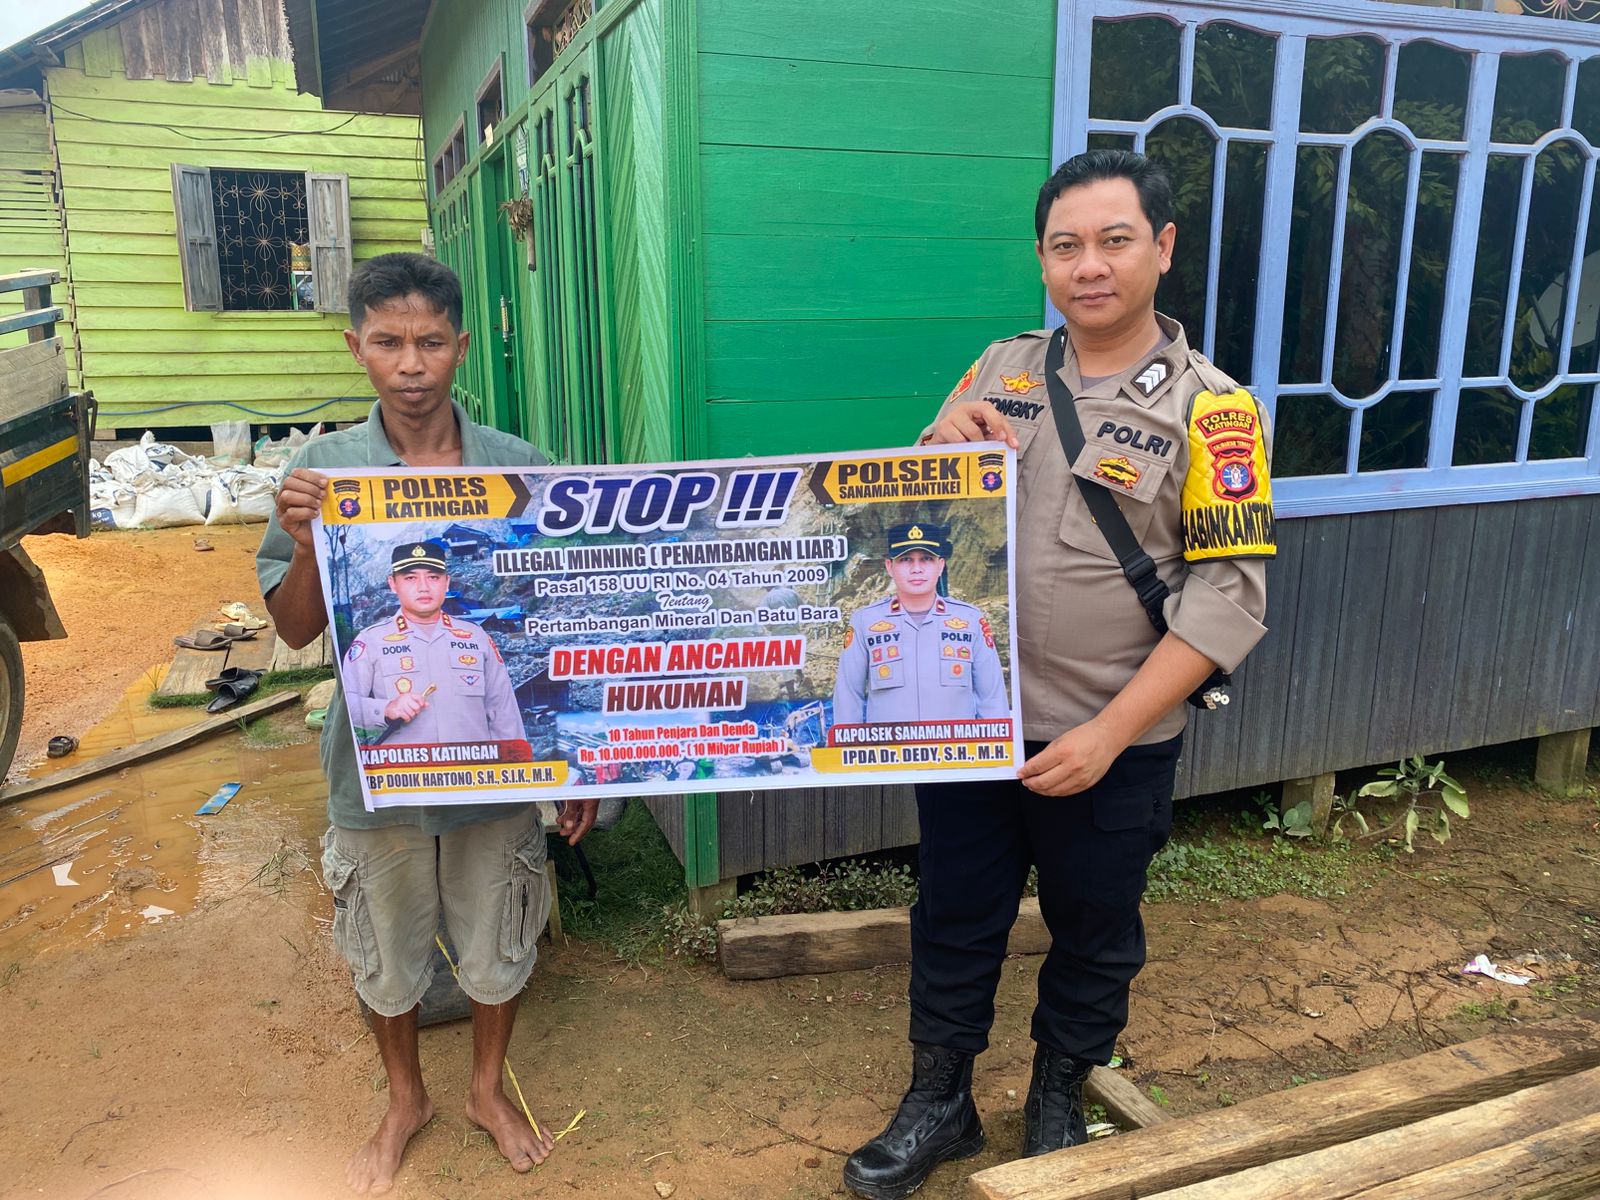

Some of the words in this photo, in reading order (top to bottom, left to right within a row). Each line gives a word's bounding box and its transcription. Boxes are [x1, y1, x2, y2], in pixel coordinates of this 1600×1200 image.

[983, 397, 1044, 420] ONGKY
[1201, 412, 1252, 427] POLRES
[1208, 421, 1249, 431] KATINGAN
[1097, 421, 1172, 457] POLRI
[838, 457, 961, 485] POLSEK
[383, 477, 487, 500] POLRES
[839, 484, 899, 499] SANAMAN
[902, 481, 961, 496] MANTIKEI
[385, 499, 489, 519] KATINGAN
[543, 475, 716, 528] STOP
[721, 471, 798, 522] !!!
[496, 551, 564, 573] ILLEGAL
[567, 549, 646, 570] MINNING
[662, 540, 793, 565] PENAMBANGAN
[797, 539, 833, 560] LIAR
[538, 579, 583, 596] Pasal
[587, 577, 618, 592] 158
[623, 577, 648, 591] UU
[654, 576, 671, 589] RI
[676, 573, 703, 588] No.
[708, 572, 727, 586] 04
[732, 570, 782, 586] Tahun
[787, 568, 825, 583] 2009
[659, 594, 712, 609] Tentang
[528, 616, 650, 634] Pertambangan
[655, 611, 715, 628] Mineral
[721, 610, 754, 625] Dan
[758, 609, 796, 623] Batu
[801, 607, 838, 621] Bara
[451, 641, 479, 650] POLRI
[867, 633, 900, 646] DEDY
[941, 632, 971, 642] POLRI
[382, 645, 411, 655] DODIK
[553, 647, 664, 677] DENGAN
[667, 639, 802, 671] ANCAMAN
[607, 680, 743, 712] HUKUMAN
[609, 729, 620, 742] 10
[623, 728, 654, 741] Tahun
[657, 726, 697, 739] Penjara
[700, 725, 719, 737] Dan
[722, 722, 754, 736] Denda
[835, 727, 893, 743] KAPOLSEK
[895, 725, 952, 741] SANAMAN
[953, 724, 1009, 738] MANTIKEI
[361, 748, 428, 764] KAPOLRES
[431, 745, 498, 761] KATINGAN
[581, 749, 597, 762] Rp.
[694, 743, 705, 755] 10
[708, 742, 739, 755] Milyar
[742, 740, 778, 754] Rupiah
[843, 750, 877, 765] IPDA
[880, 749, 899, 763] Dr.
[903, 748, 940, 764] DEDY,
[943, 747, 974, 762] S.H.,
[978, 745, 1008, 760] M.H.
[387, 773, 420, 787] DODIK
[422, 769, 475, 786] HARTONO,
[477, 769, 500, 785] S.H.,
[502, 768, 530, 784] S.I.K.,
[532, 767, 555, 782] M.H.
